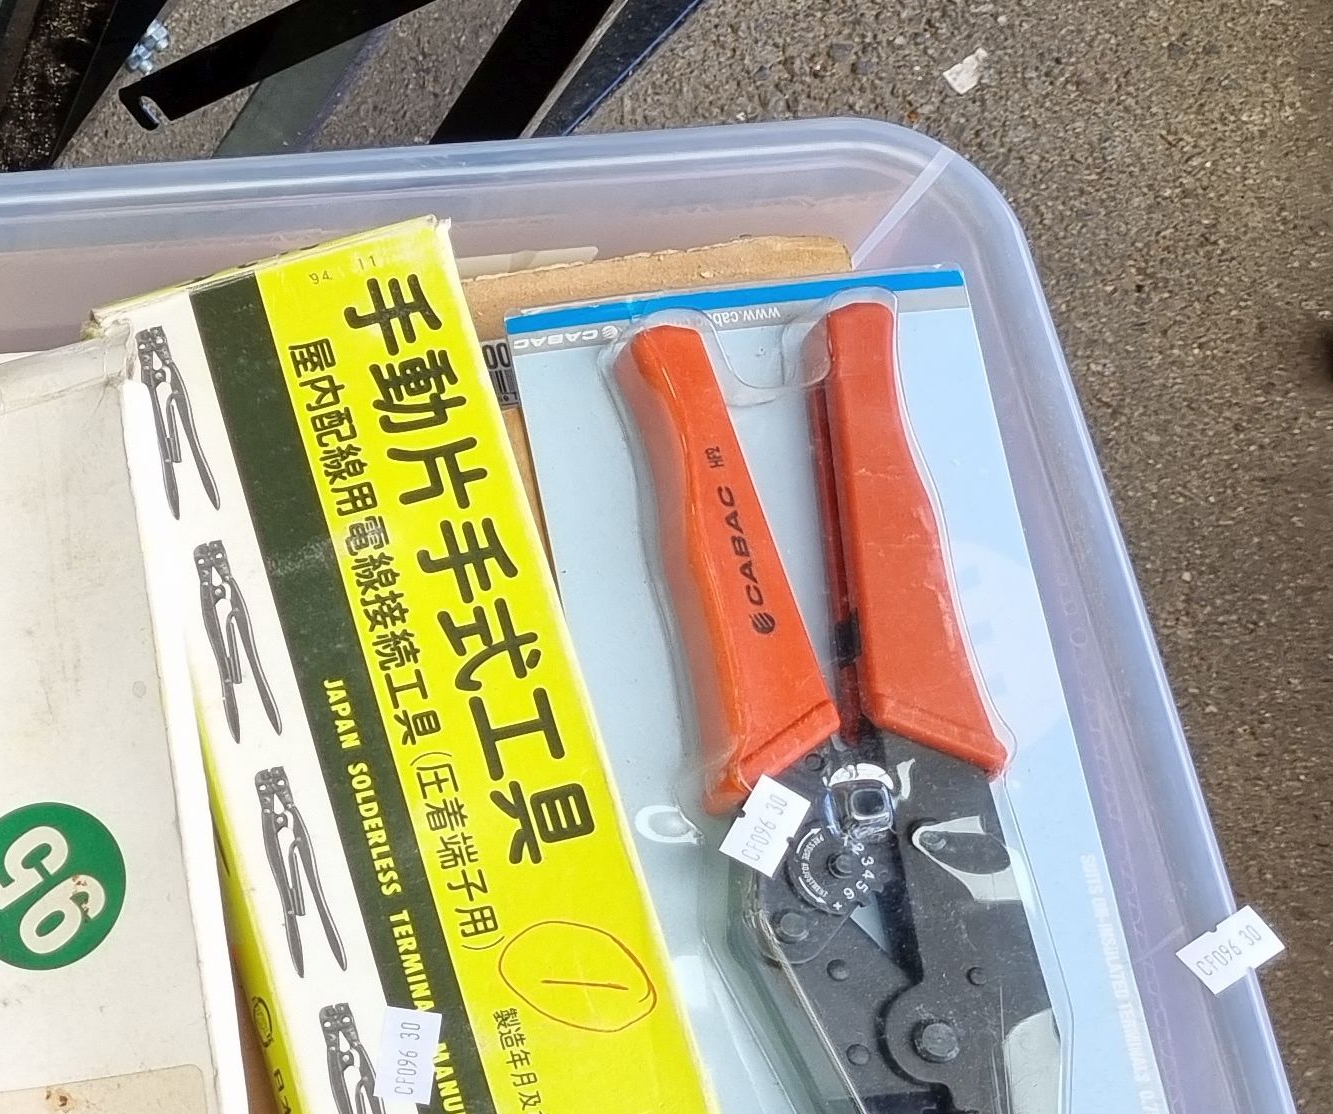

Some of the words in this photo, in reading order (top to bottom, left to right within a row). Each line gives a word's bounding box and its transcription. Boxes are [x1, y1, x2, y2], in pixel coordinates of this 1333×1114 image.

[513, 328, 599, 350] CABAC
[343, 273, 594, 864] 手動片手式工具
[724, 485, 764, 609] CABAC
[324, 678, 361, 751] JAPAN
[347, 762, 402, 896] SOLDERLESS
[389, 909, 434, 1013] TERMINA
[741, 817, 776, 861] CF096
[766, 793, 788, 815] 30
[860, 856, 875, 866] 3
[862, 870, 875, 879] 4
[856, 880, 869, 893] 5
[1196, 939, 1242, 976] CF096
[1238, 924, 1262, 945] 30
[399, 1021, 421, 1041] 30
[394, 1050, 418, 1095] CF096
